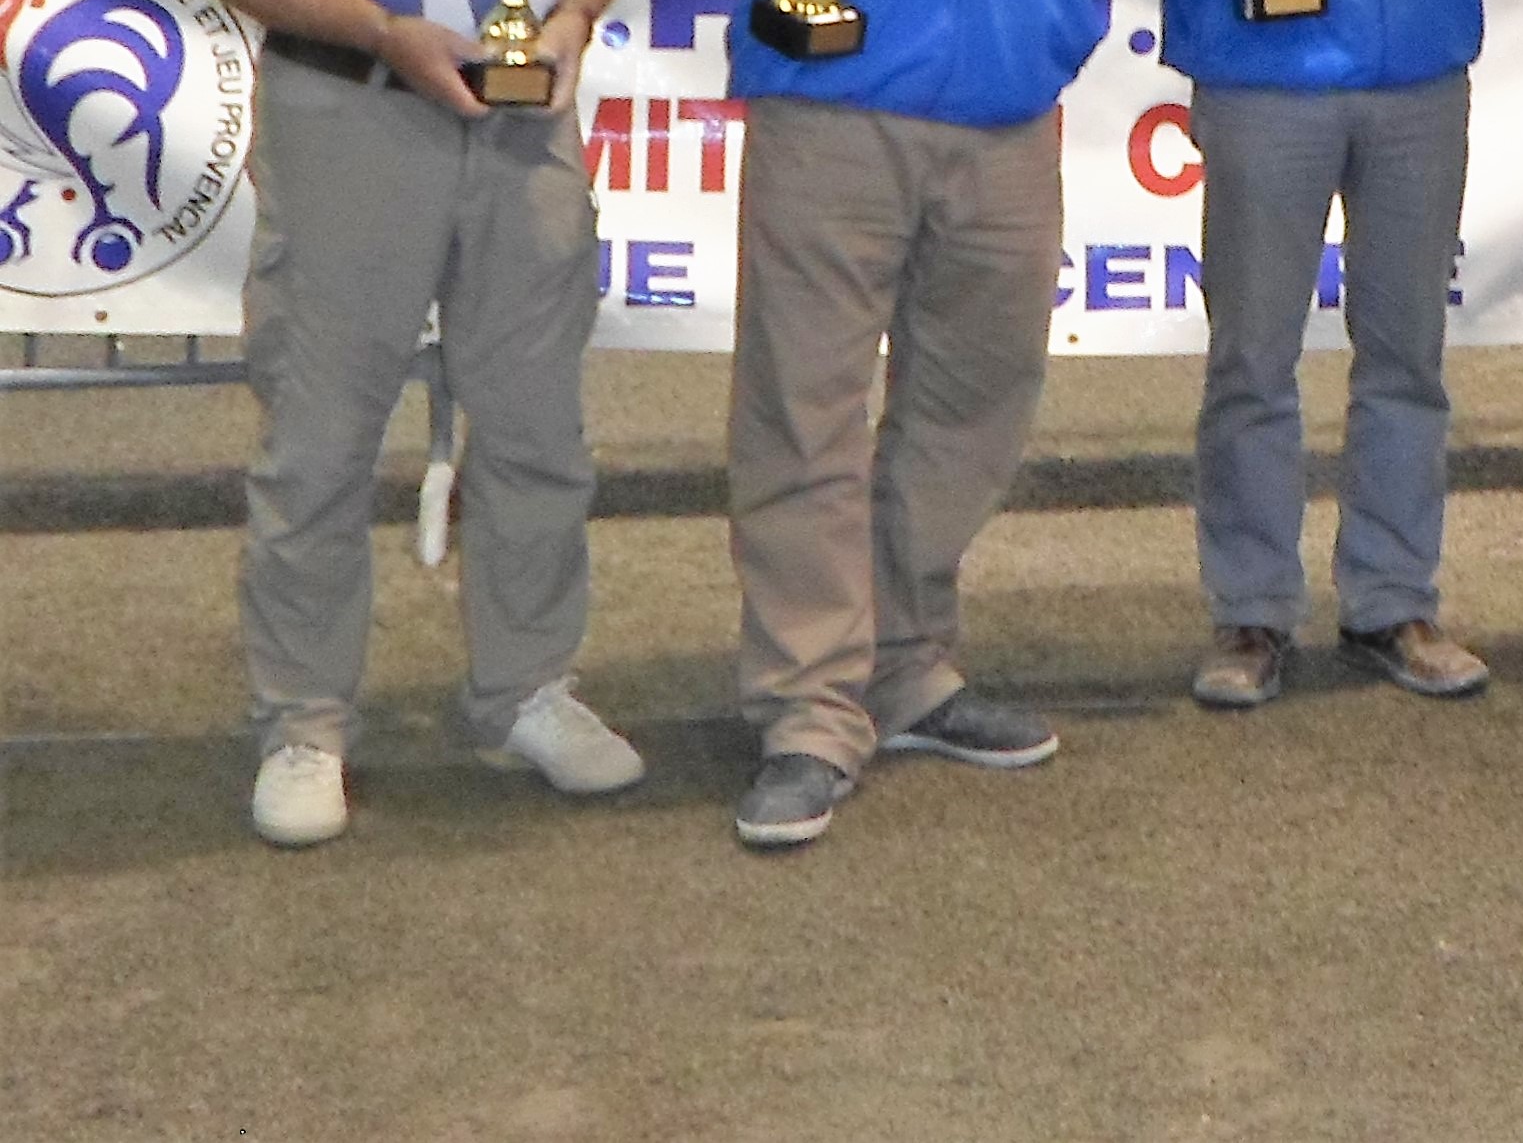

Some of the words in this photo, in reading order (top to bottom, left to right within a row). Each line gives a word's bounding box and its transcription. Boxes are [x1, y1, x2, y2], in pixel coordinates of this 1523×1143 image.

[193, 6, 231, 37] ET
[211, 42, 243, 94] JEU
[152, 103, 243, 244] PROVENCAL
